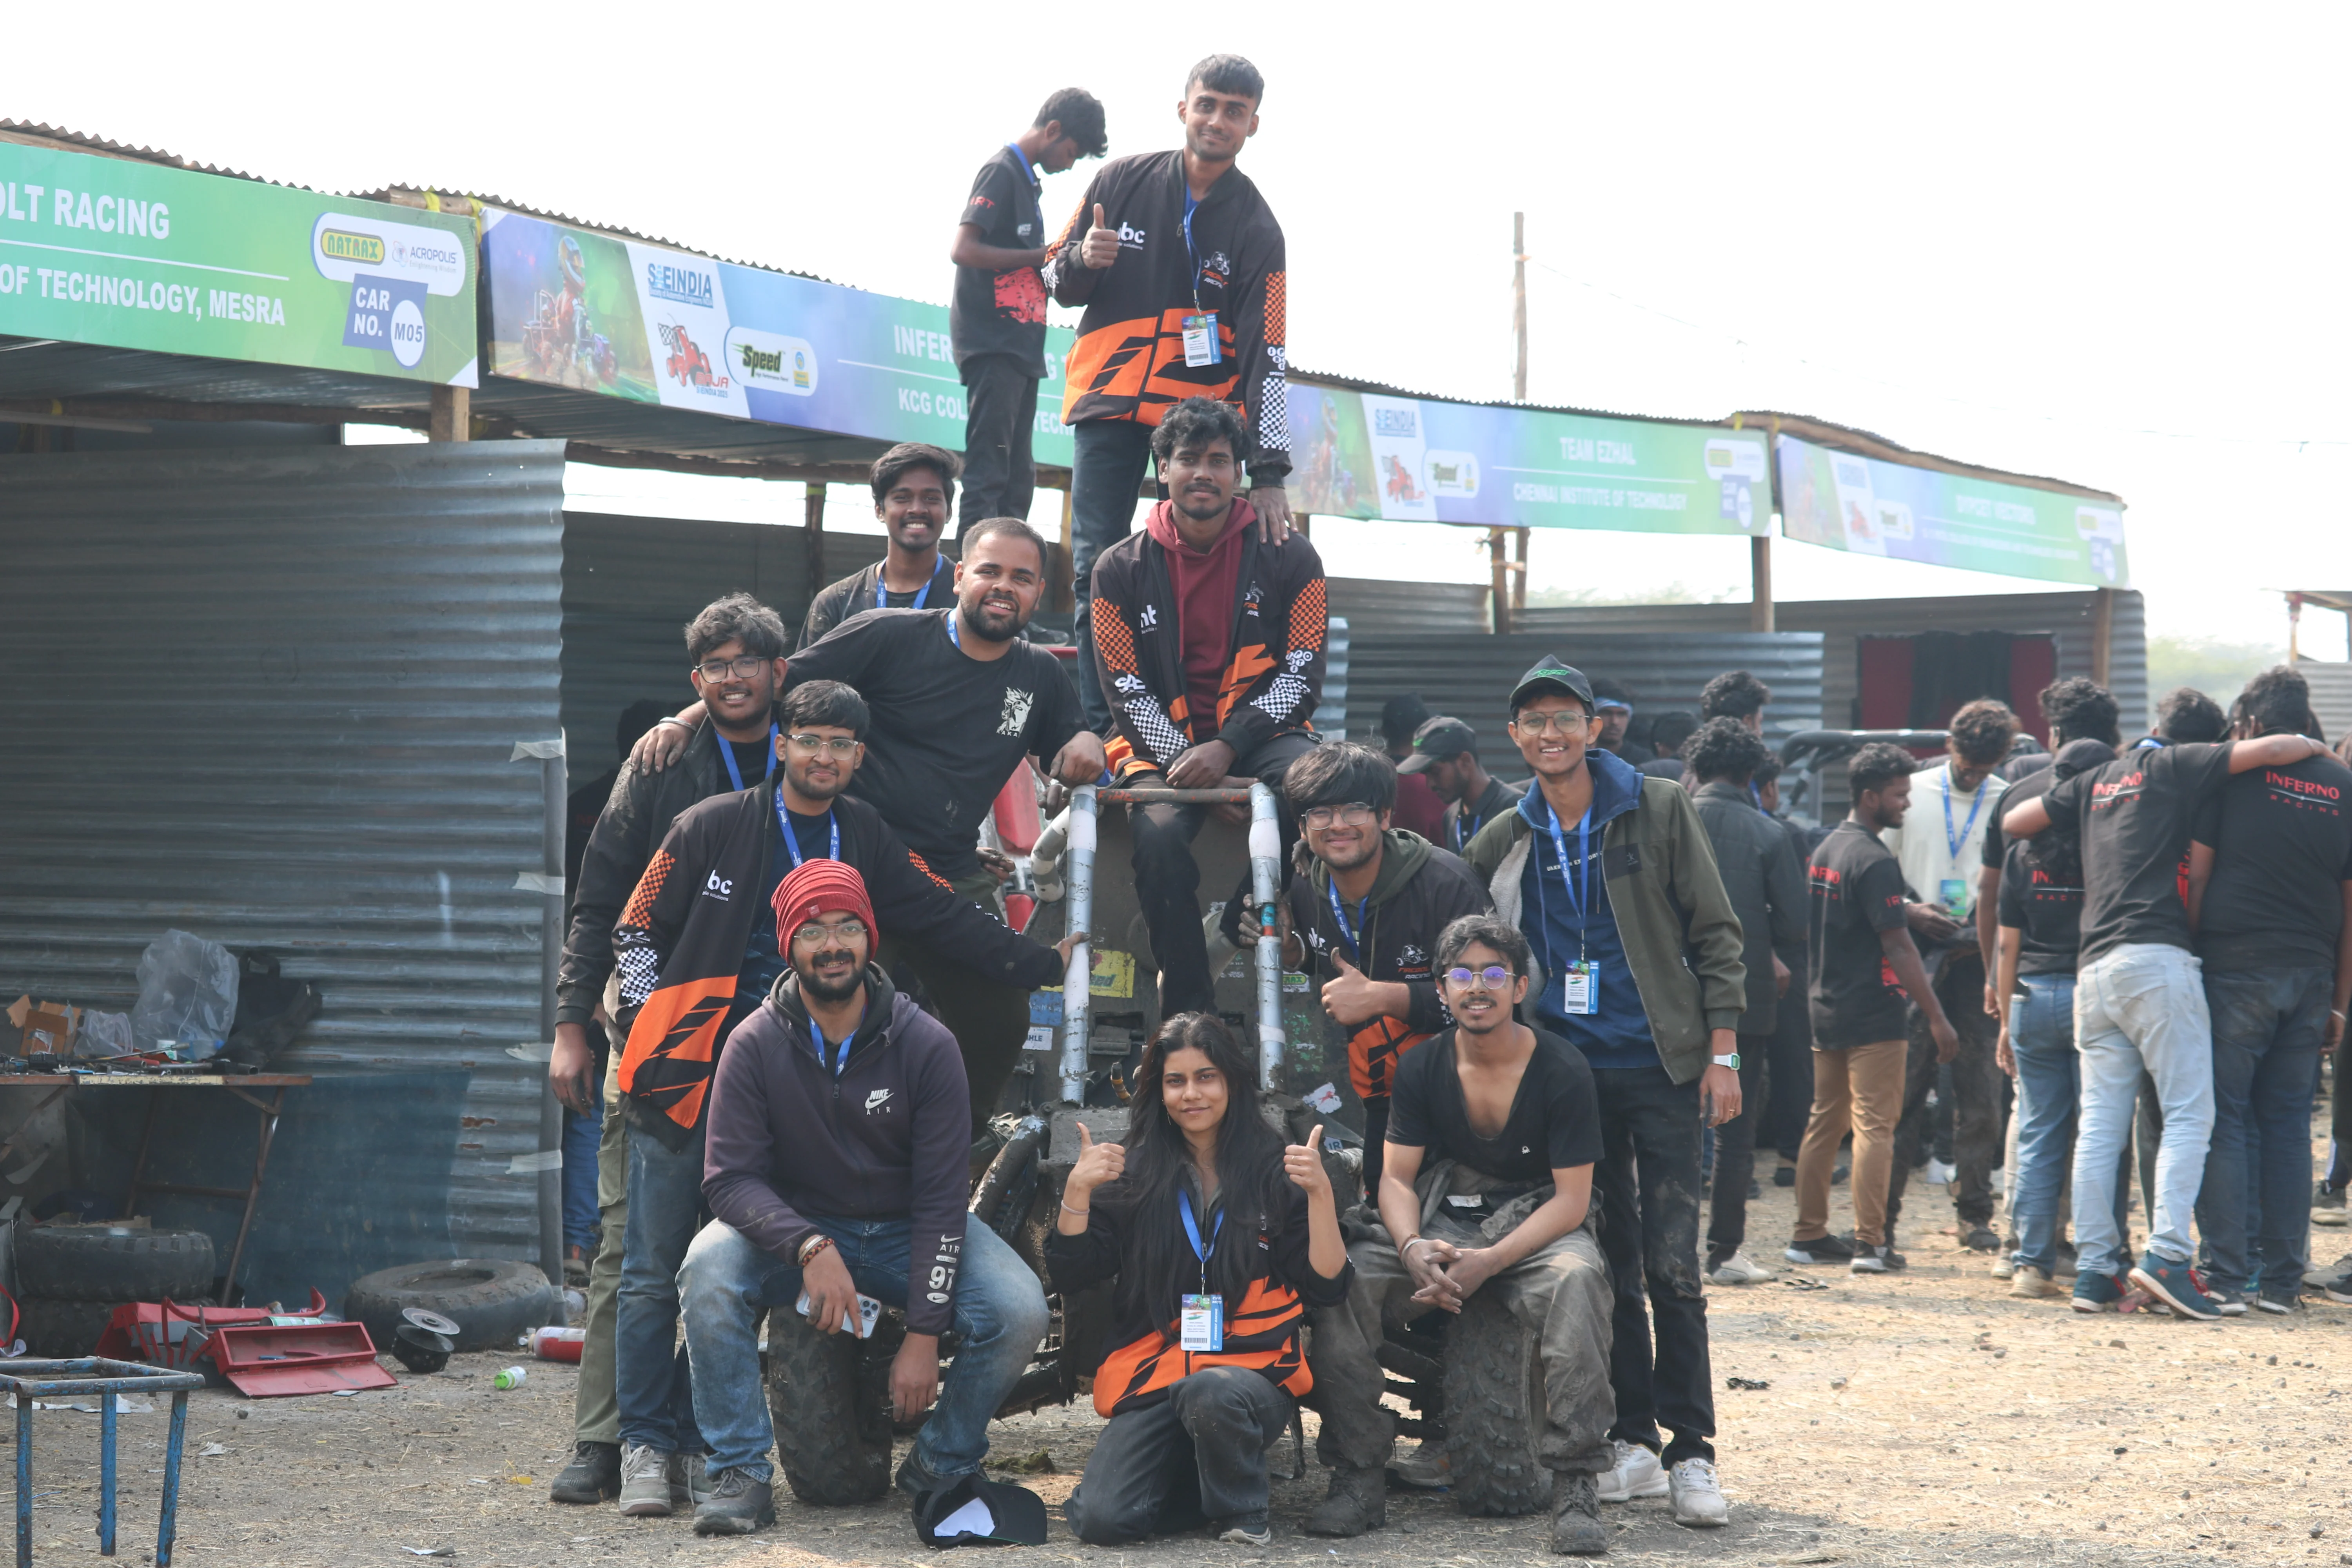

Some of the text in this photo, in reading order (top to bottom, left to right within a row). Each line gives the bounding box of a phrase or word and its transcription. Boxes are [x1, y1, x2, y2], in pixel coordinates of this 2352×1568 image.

[54, 188, 169, 240] RACING
[970, 196, 995, 209] IRT
[327, 234, 378, 260] NATRAX
[410, 247, 456, 264] ACROPOLIS
[0, 263, 285, 326] OF TECHNOLOGY, MESRA
[356, 287, 390, 311] CAR
[354, 313, 383, 337] NO.
[394, 323, 423, 342] M05
[894, 325, 953, 363] INFER
[742, 344, 782, 377] Speed
[695, 372, 728, 388] BAJA
[898, 387, 1075, 436] KCG COL TECH
[1560, 437, 1594, 461] TEAM
[996, 730, 1020, 738] KAKA
[2265, 771, 2340, 800] INFERNO
[2270, 794, 2339, 816] RACING
[710, 892, 729, 902] solutions
[1886, 895, 1901, 907] IR
[869, 1088, 889, 1100] NIKE
[866, 1106, 891, 1116] AIR
[940, 1244, 960, 1254] AIR
[929, 1266, 956, 1291] 97
